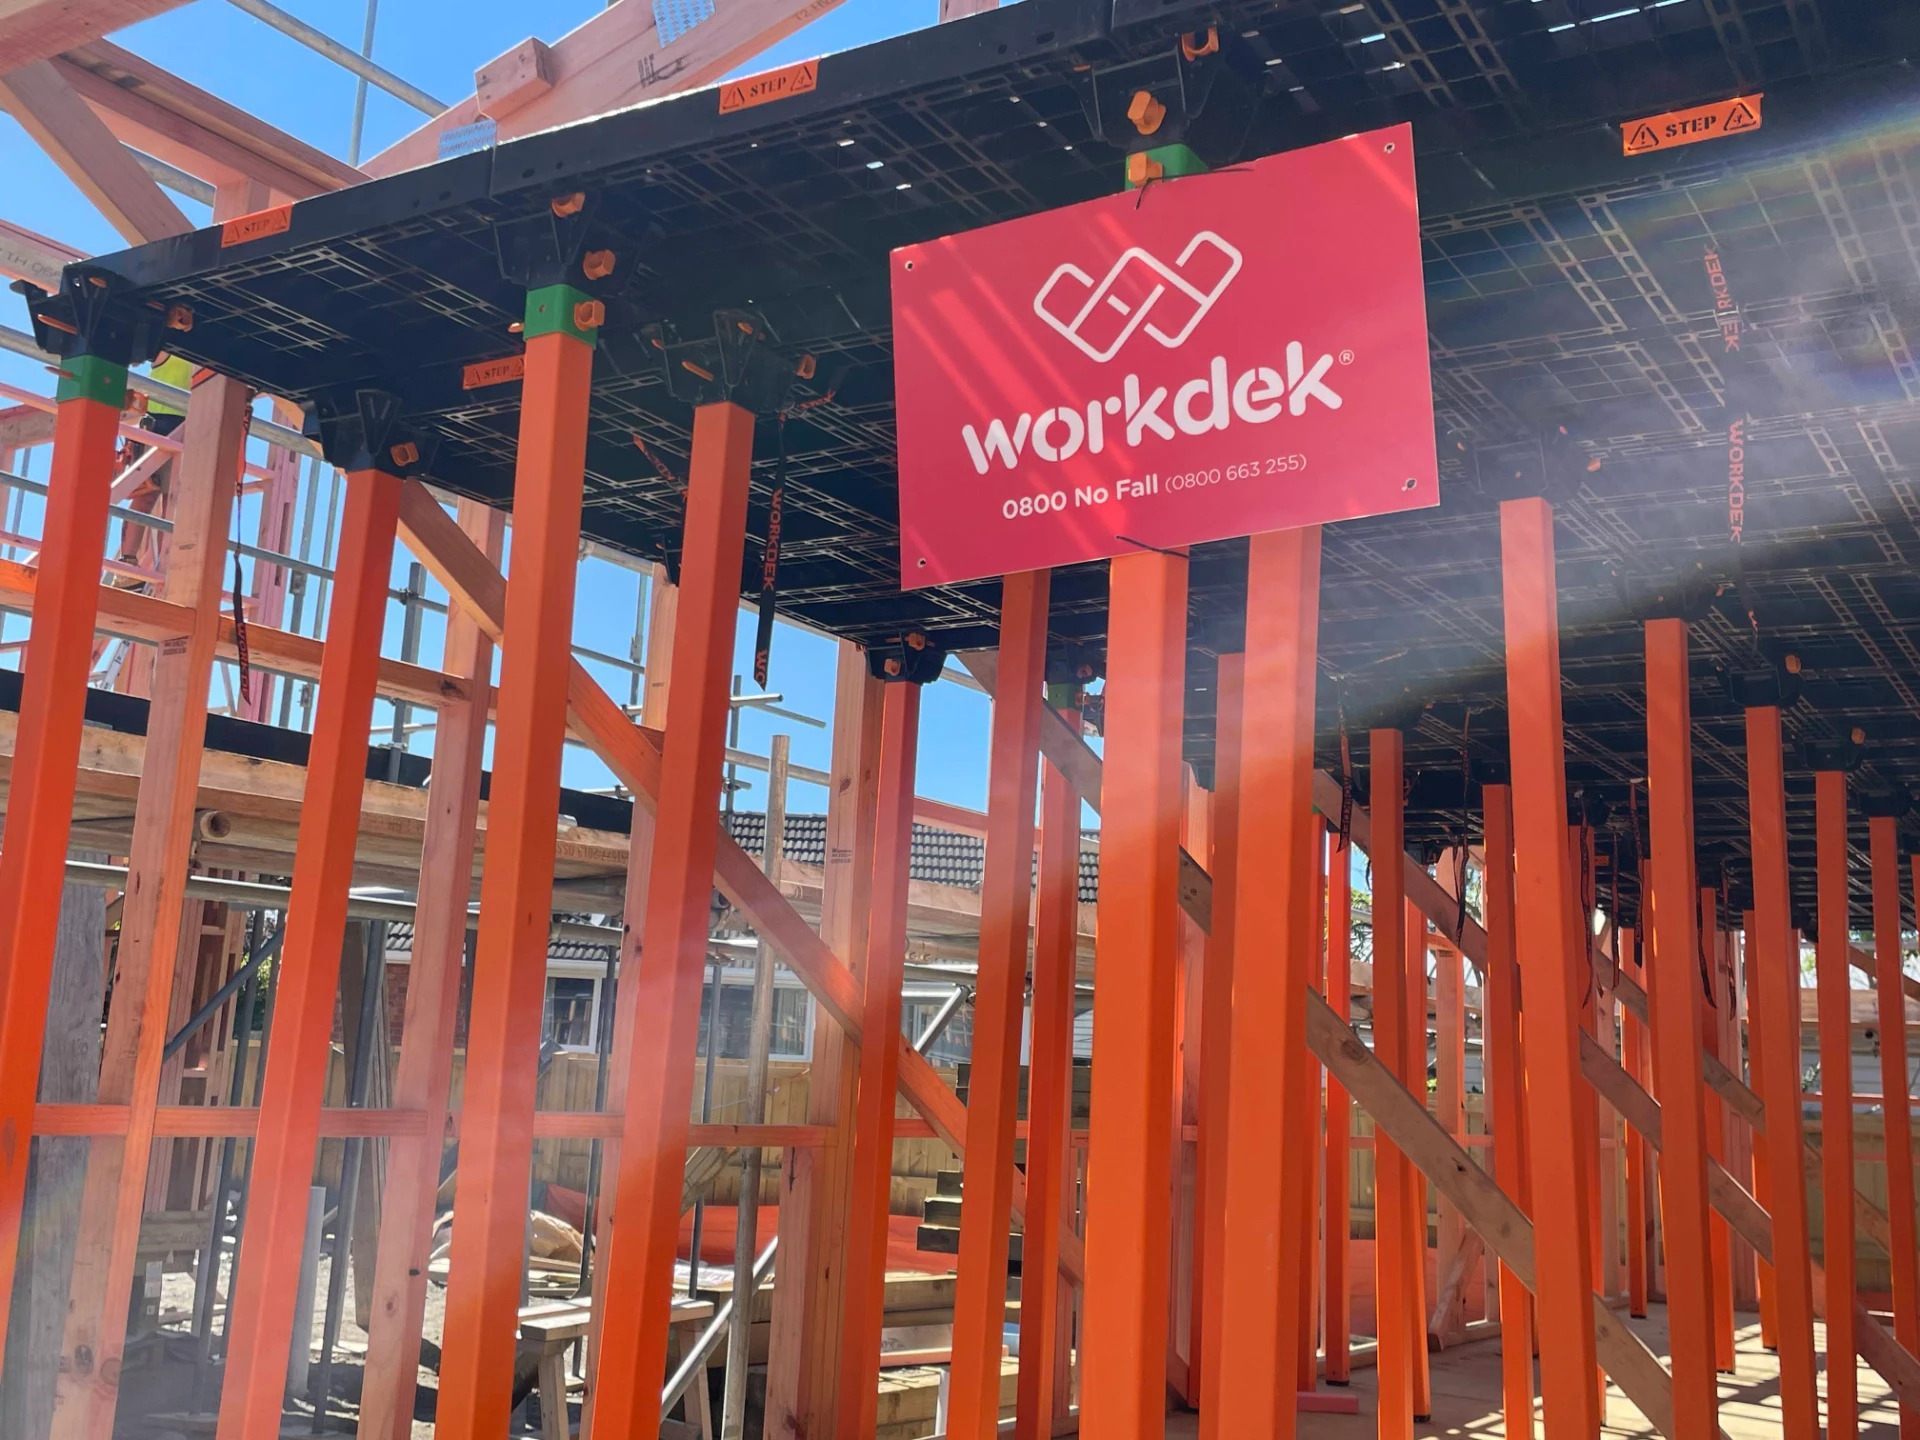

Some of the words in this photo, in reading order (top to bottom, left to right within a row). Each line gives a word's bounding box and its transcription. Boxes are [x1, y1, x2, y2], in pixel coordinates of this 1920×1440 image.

[750, 76, 787, 98] STEP
[1664, 115, 1717, 138] STEP
[1002, 490, 1067, 520] 0800
[1074, 486, 1109, 508] No
[1116, 473, 1159, 501] Fall
[1164, 469, 1221, 494] (0800
[1226, 465, 1260, 482] 663
[1265, 453, 1307, 475] 255)
[1728, 419, 1744, 544] WORKDEK
[763, 487, 783, 591] WORKDEK
